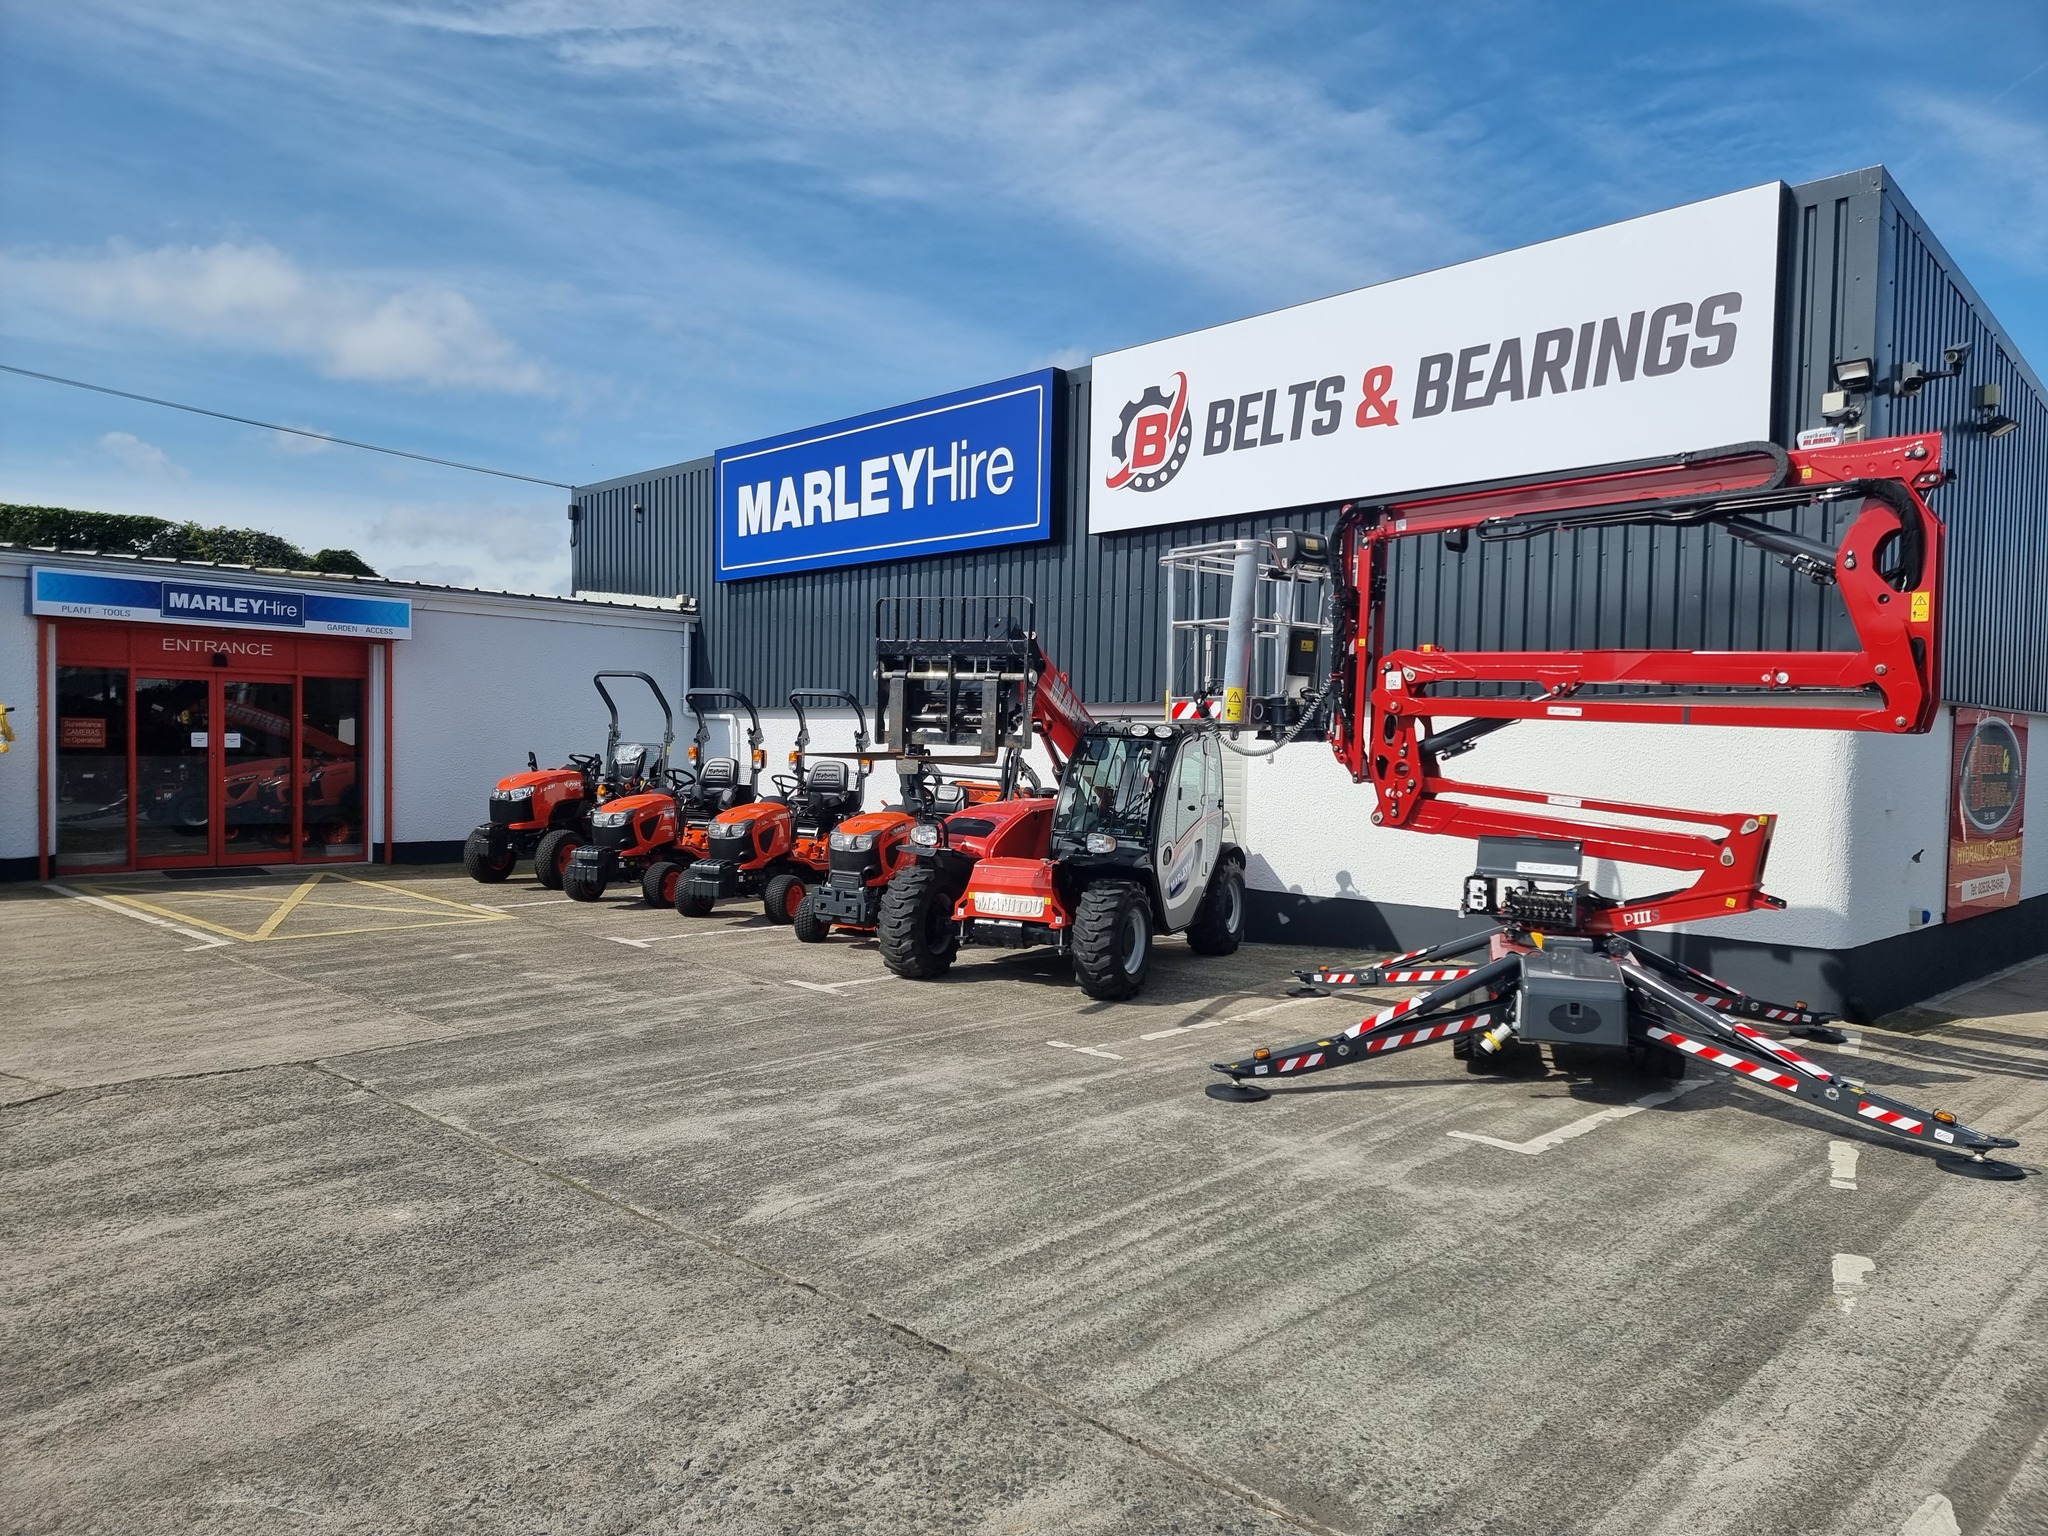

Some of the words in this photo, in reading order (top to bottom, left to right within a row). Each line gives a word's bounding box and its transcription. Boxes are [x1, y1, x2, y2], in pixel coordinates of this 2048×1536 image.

[1202, 375, 1346, 457] BELTS
[1355, 364, 1400, 430] &
[1412, 290, 1743, 420] BEARINGS
[738, 438, 1015, 537] MARLEYHire
[61, 605, 93, 615] PLANT
[102, 608, 131, 617] TOOLS
[169, 592, 298, 617] MARLEYHire
[326, 624, 358, 633] GARDEN
[365, 627, 394, 635] ACCESS
[162, 638, 273, 656] ENTRANCE
[64, 720, 102, 728] Surveillance
[1956, 843, 1991, 866] HYDRAULIC
[1990, 840, 2018, 859] SERVICES
[976, 895, 1044, 915] MANITOU
